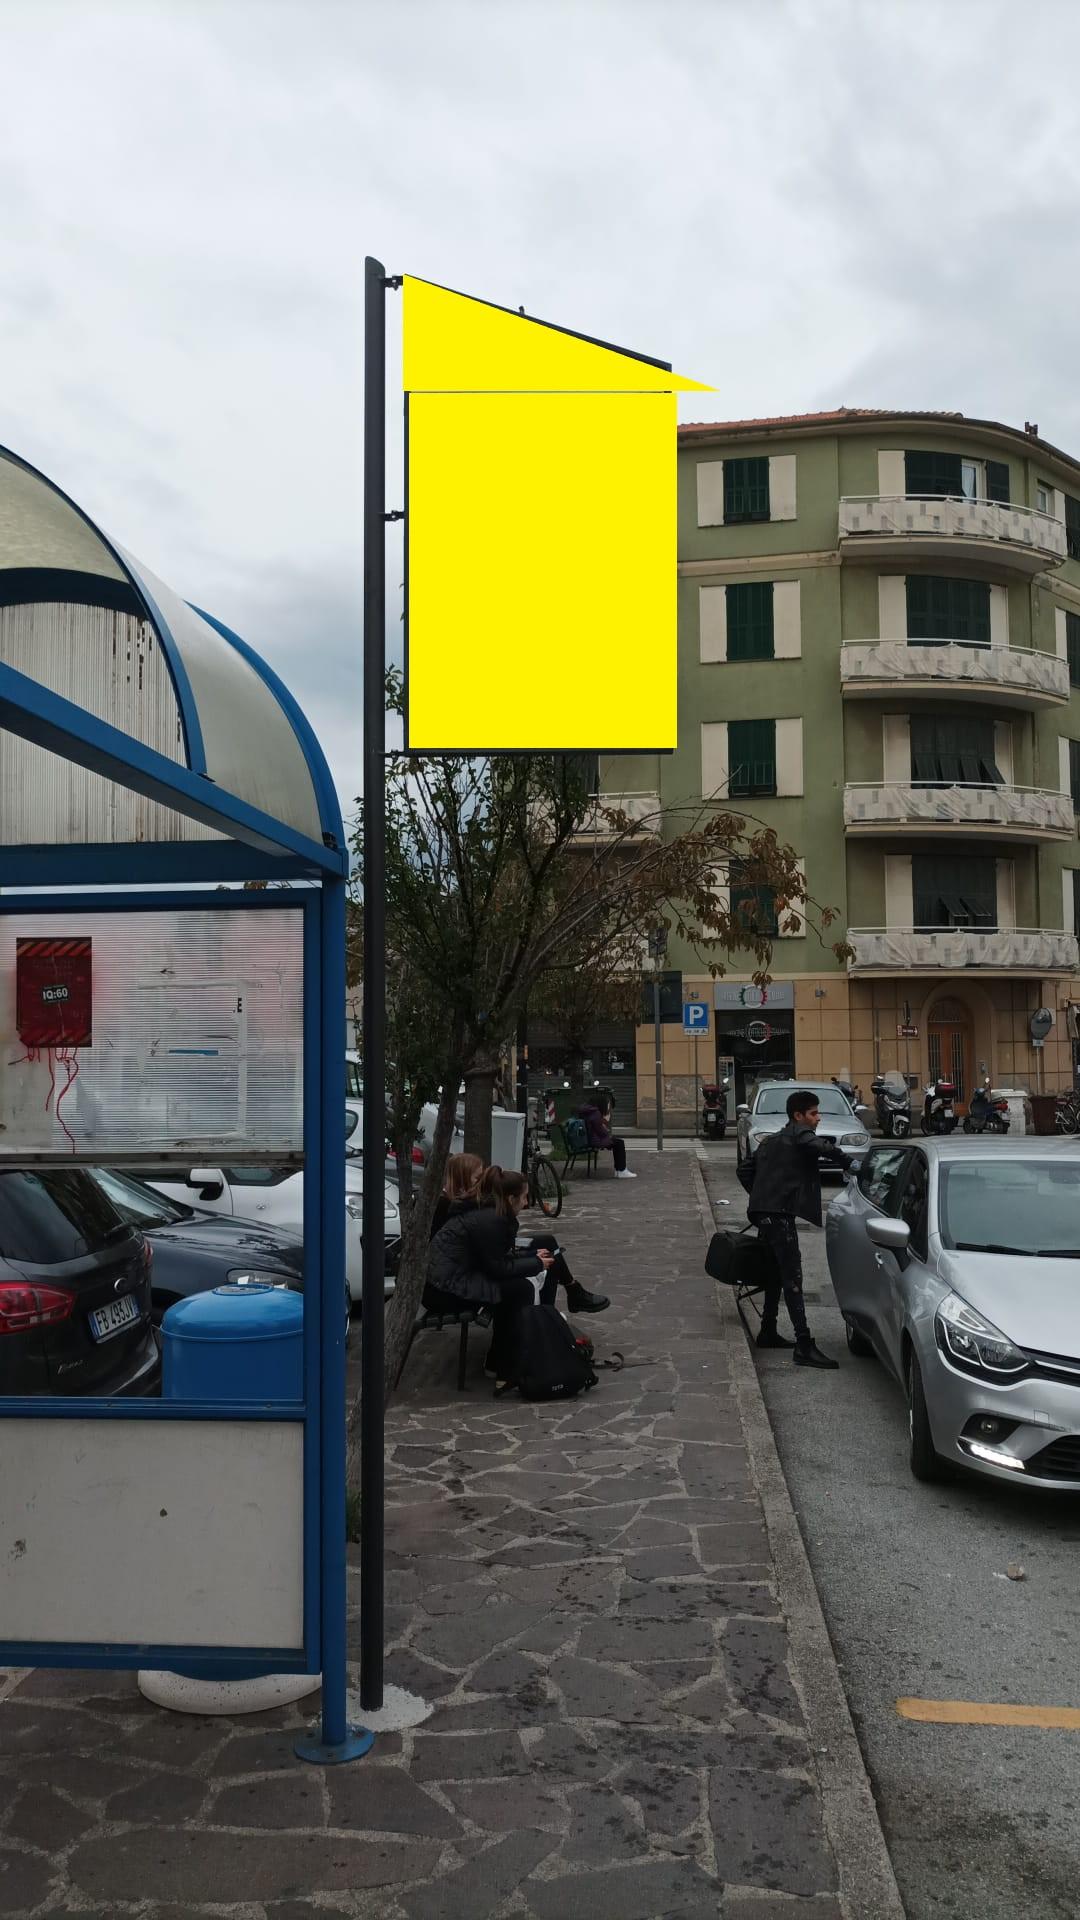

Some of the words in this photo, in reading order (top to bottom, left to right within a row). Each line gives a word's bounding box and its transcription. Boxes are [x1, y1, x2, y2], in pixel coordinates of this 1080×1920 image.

[42, 987, 69, 1001] IQ:60
[689, 1005, 704, 1025] P
[95, 1310, 110, 1333] FB
